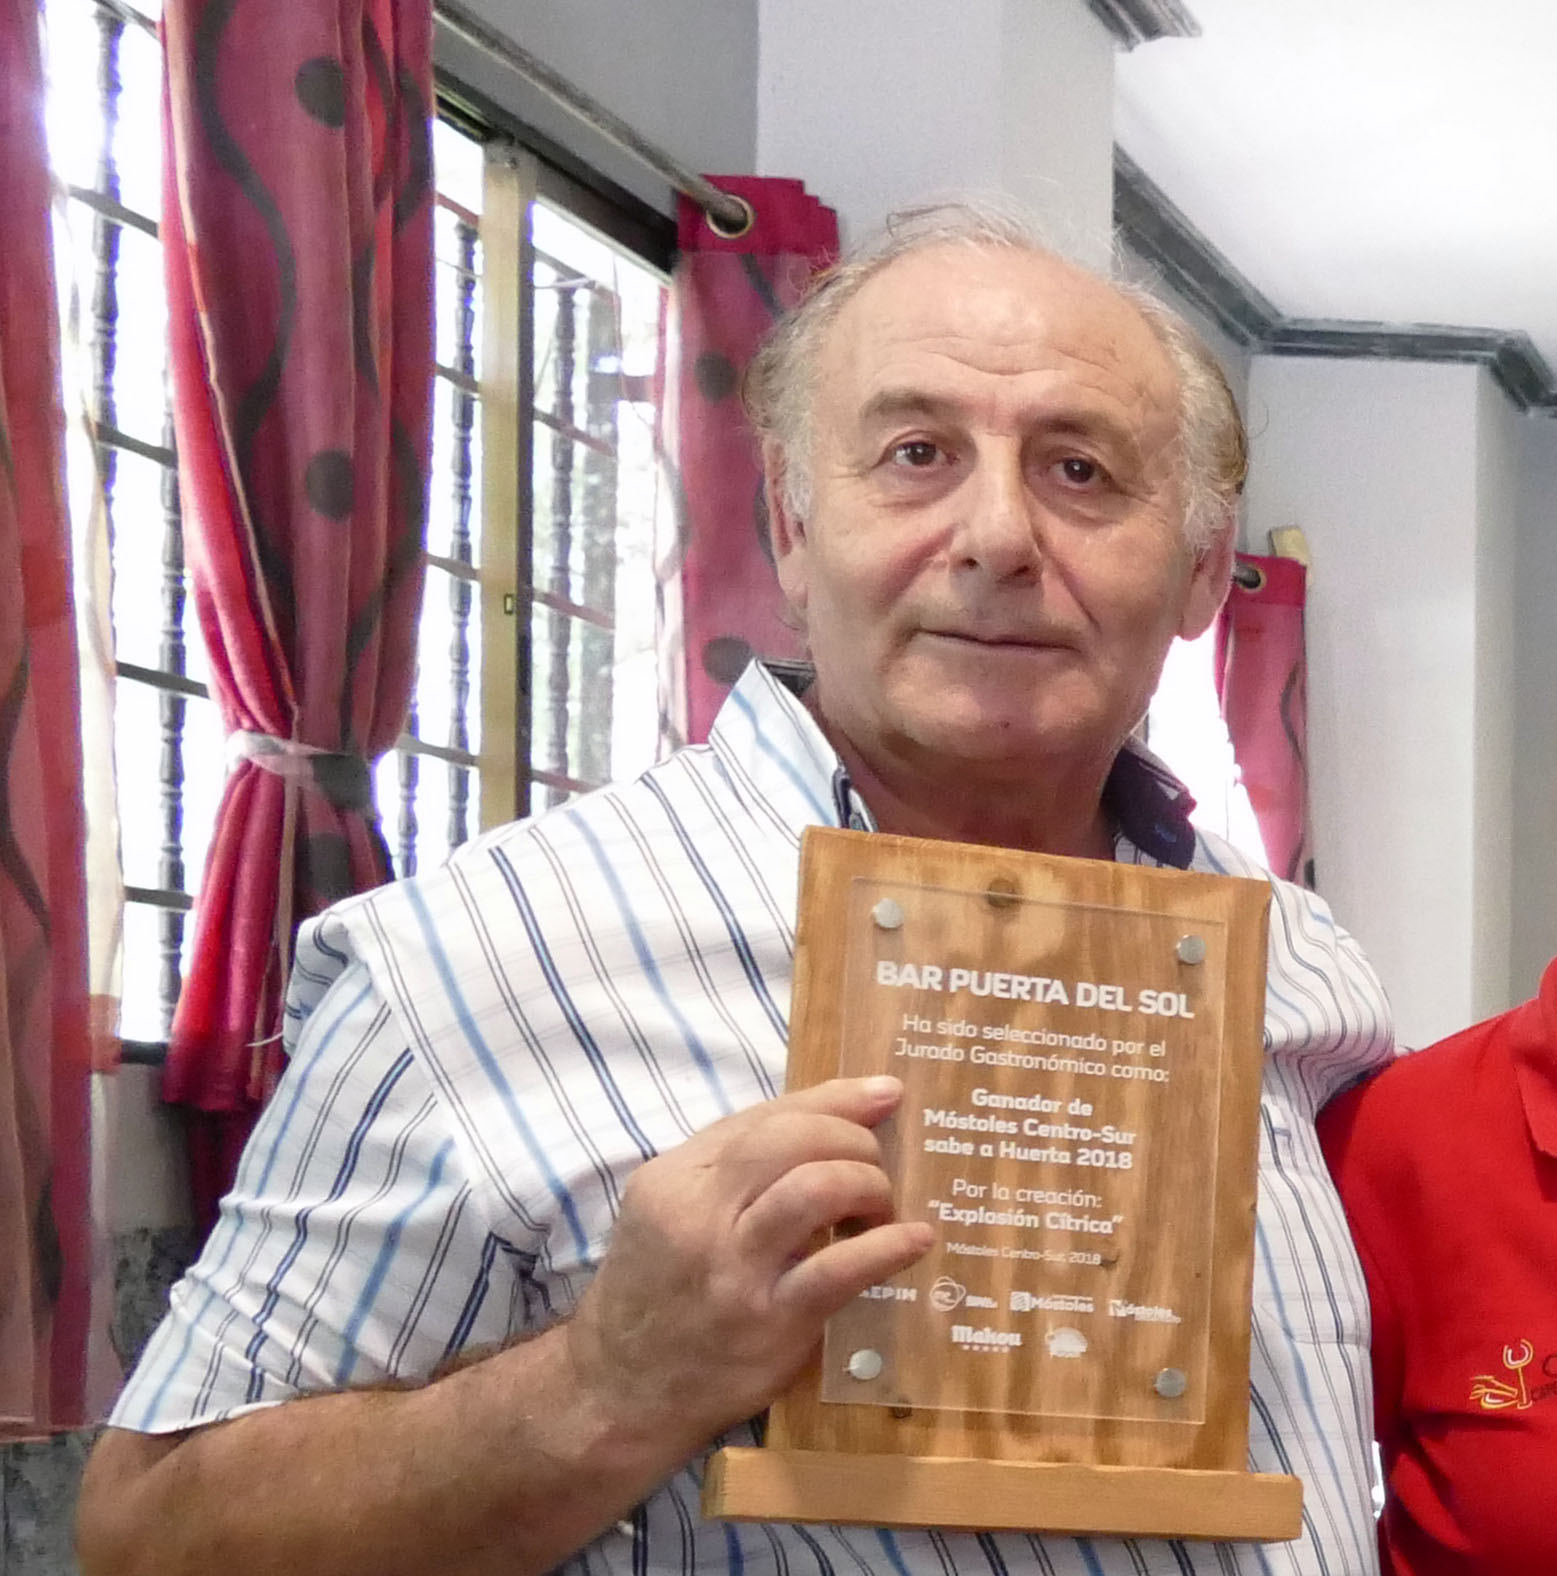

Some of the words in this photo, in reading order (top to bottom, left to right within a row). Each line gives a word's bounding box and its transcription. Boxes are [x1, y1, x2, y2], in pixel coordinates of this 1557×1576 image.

[876, 960, 942, 991] BAR
[950, 968, 1069, 1005] PUERTA
[1076, 982, 1132, 1013] DEL
[1138, 989, 1195, 1019] SOL
[903, 1014, 931, 1034] Ha
[937, 1018, 977, 1038] sido
[982, 1023, 1106, 1049] seleccionado
[1112, 1040, 1144, 1057] por
[1150, 1040, 1165, 1057] el
[895, 1038, 964, 1061] Jurado
[970, 1046, 1105, 1076] Gastronómico
[1111, 1063, 1169, 1083] como:
[971, 1088, 1062, 1113] Ganador
[1068, 1098, 1093, 1116] de
[923, 1108, 1018, 1134] Móstoles
[1023, 1118, 1137, 1145] Centro-Sur
[924, 1137, 974, 1155] sabe
[980, 1143, 993, 1157] a
[1000, 1140, 1071, 1164] Huerta
[1076, 1148, 1133, 1170] 2018
[952, 1178, 987, 1199] Por
[992, 1182, 1009, 1200] la
[1016, 1187, 1103, 1209] creación:
[1069, 1251, 1101, 1265] 2018
